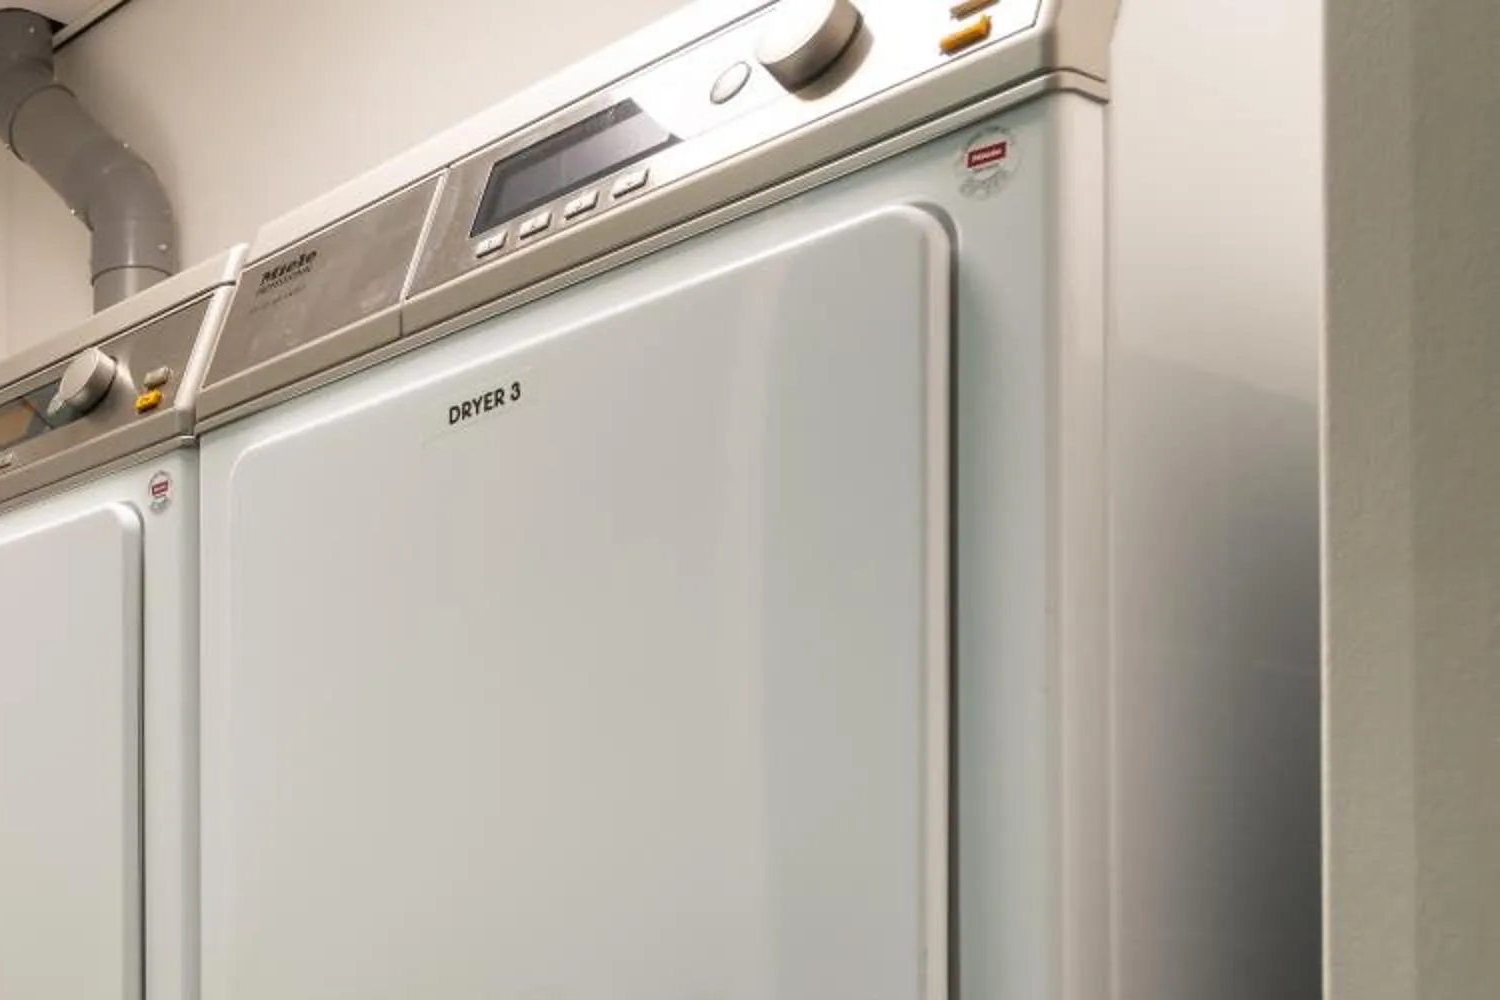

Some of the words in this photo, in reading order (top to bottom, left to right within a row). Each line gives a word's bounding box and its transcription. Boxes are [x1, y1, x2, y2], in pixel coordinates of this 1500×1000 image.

[260, 250, 317, 286] Miele
[449, 388, 505, 425] DRYER
[510, 381, 521, 401] 3
